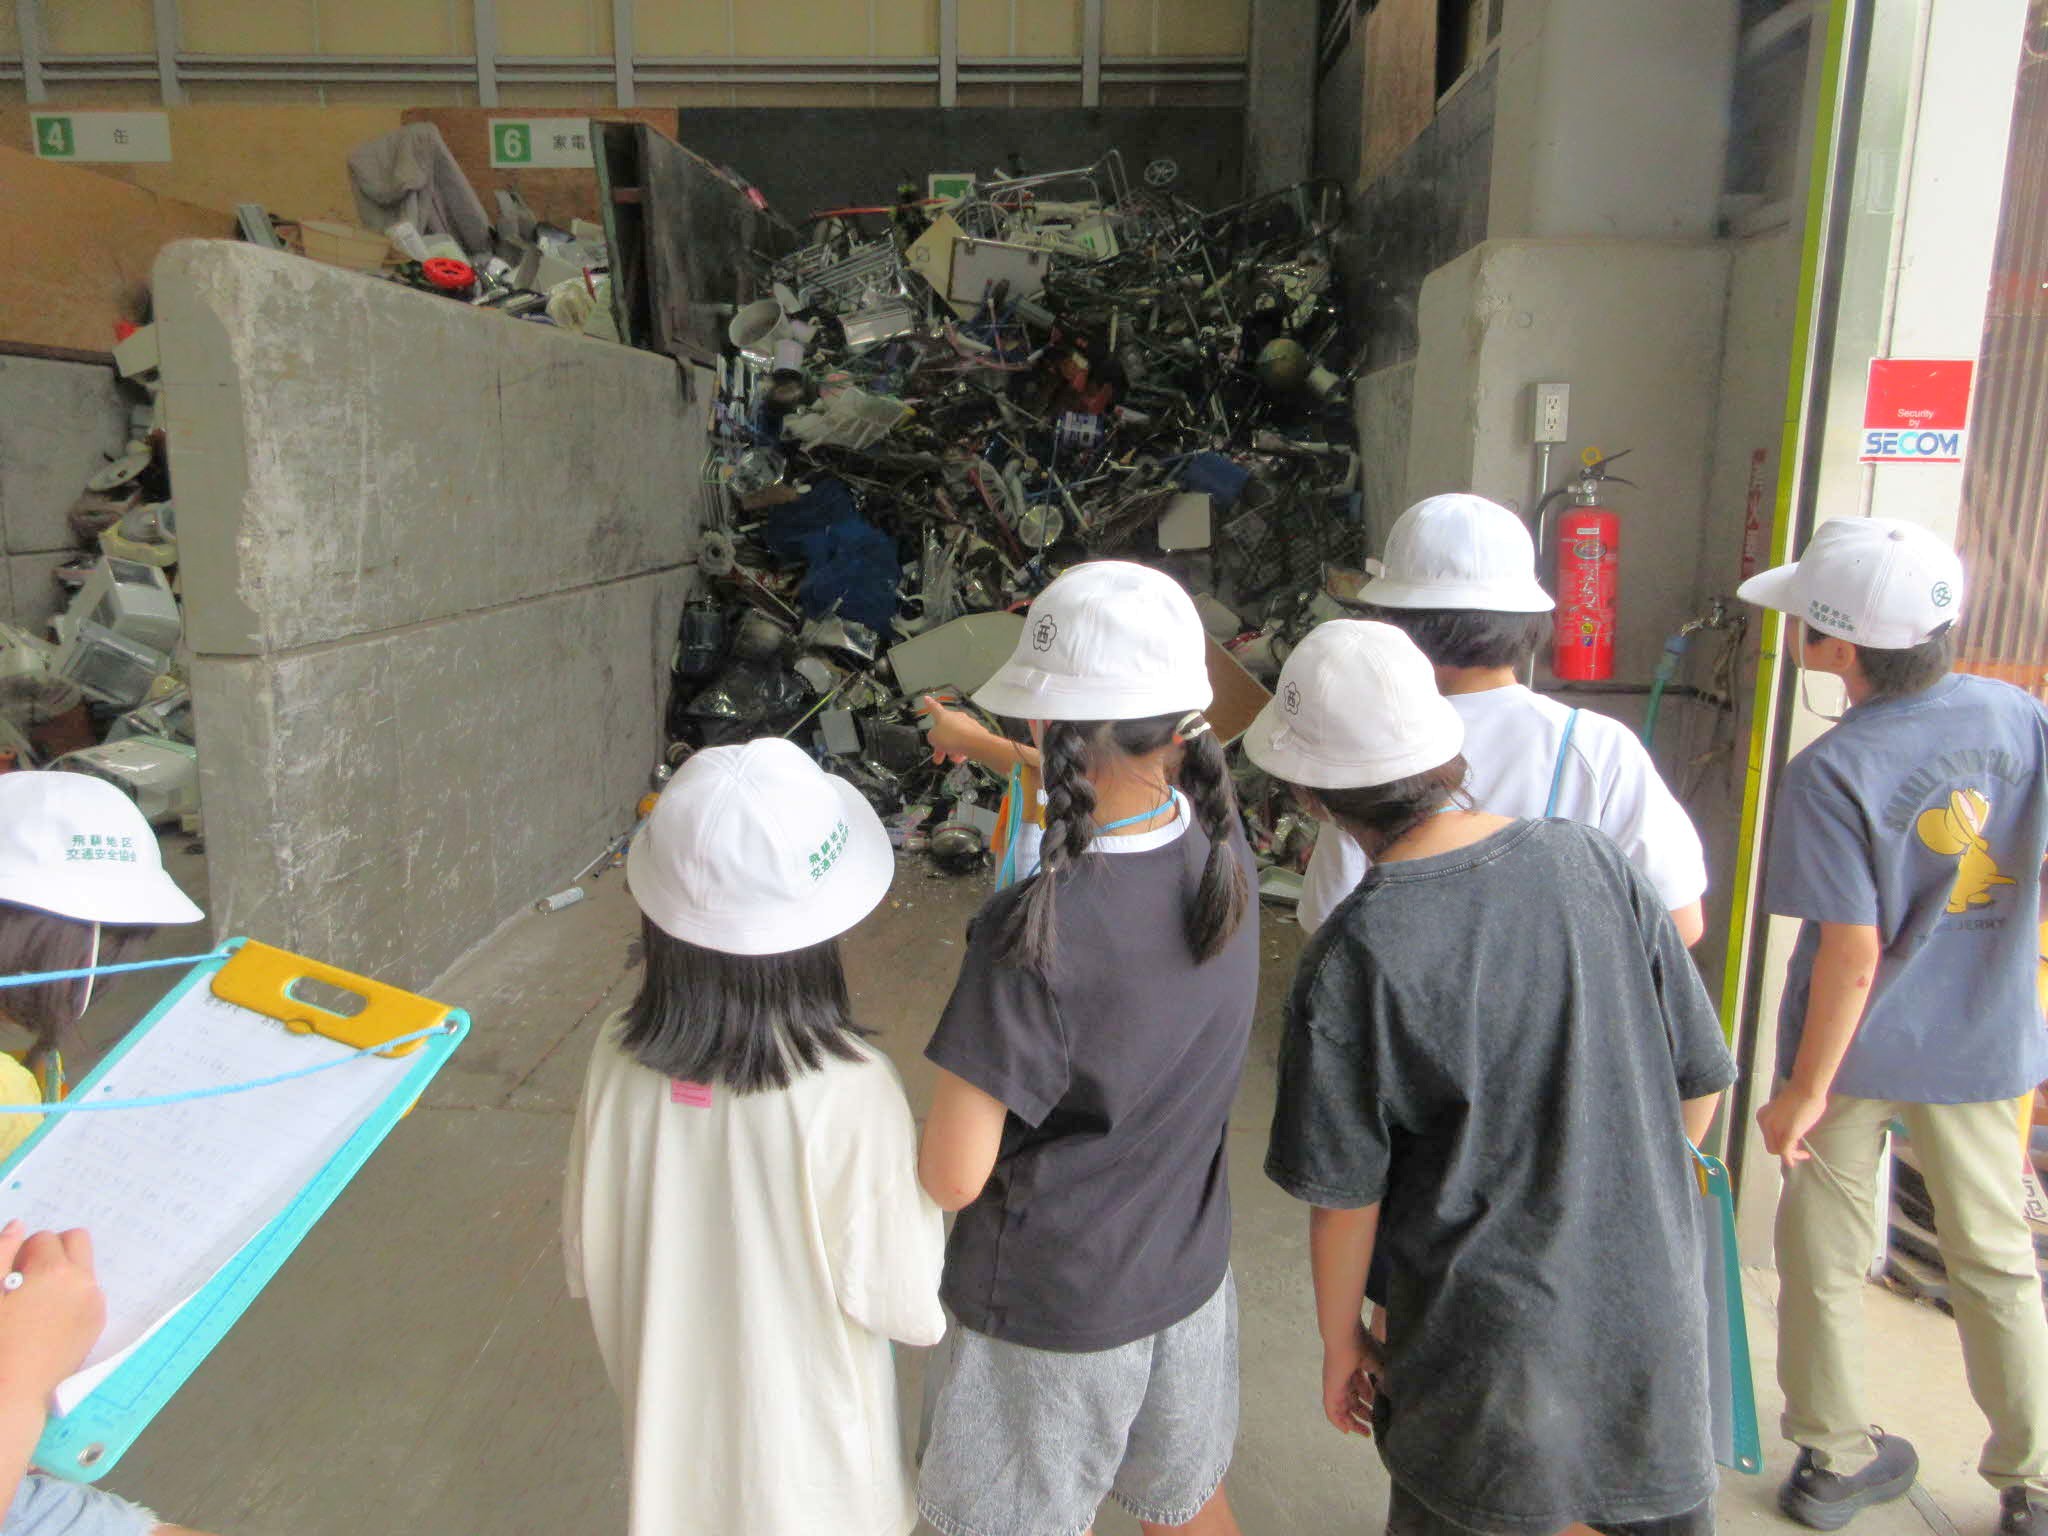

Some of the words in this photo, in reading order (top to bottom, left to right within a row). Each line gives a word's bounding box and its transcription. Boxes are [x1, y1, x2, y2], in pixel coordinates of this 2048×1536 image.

[45, 121, 65, 152] 4
[113, 128, 130, 145] 缶
[503, 128, 522, 159] 6
[552, 134, 586, 152] 家電
[1897, 408, 1934, 420] Security
[1908, 419, 1920, 429] by
[1865, 432, 1959, 456] SECOM
